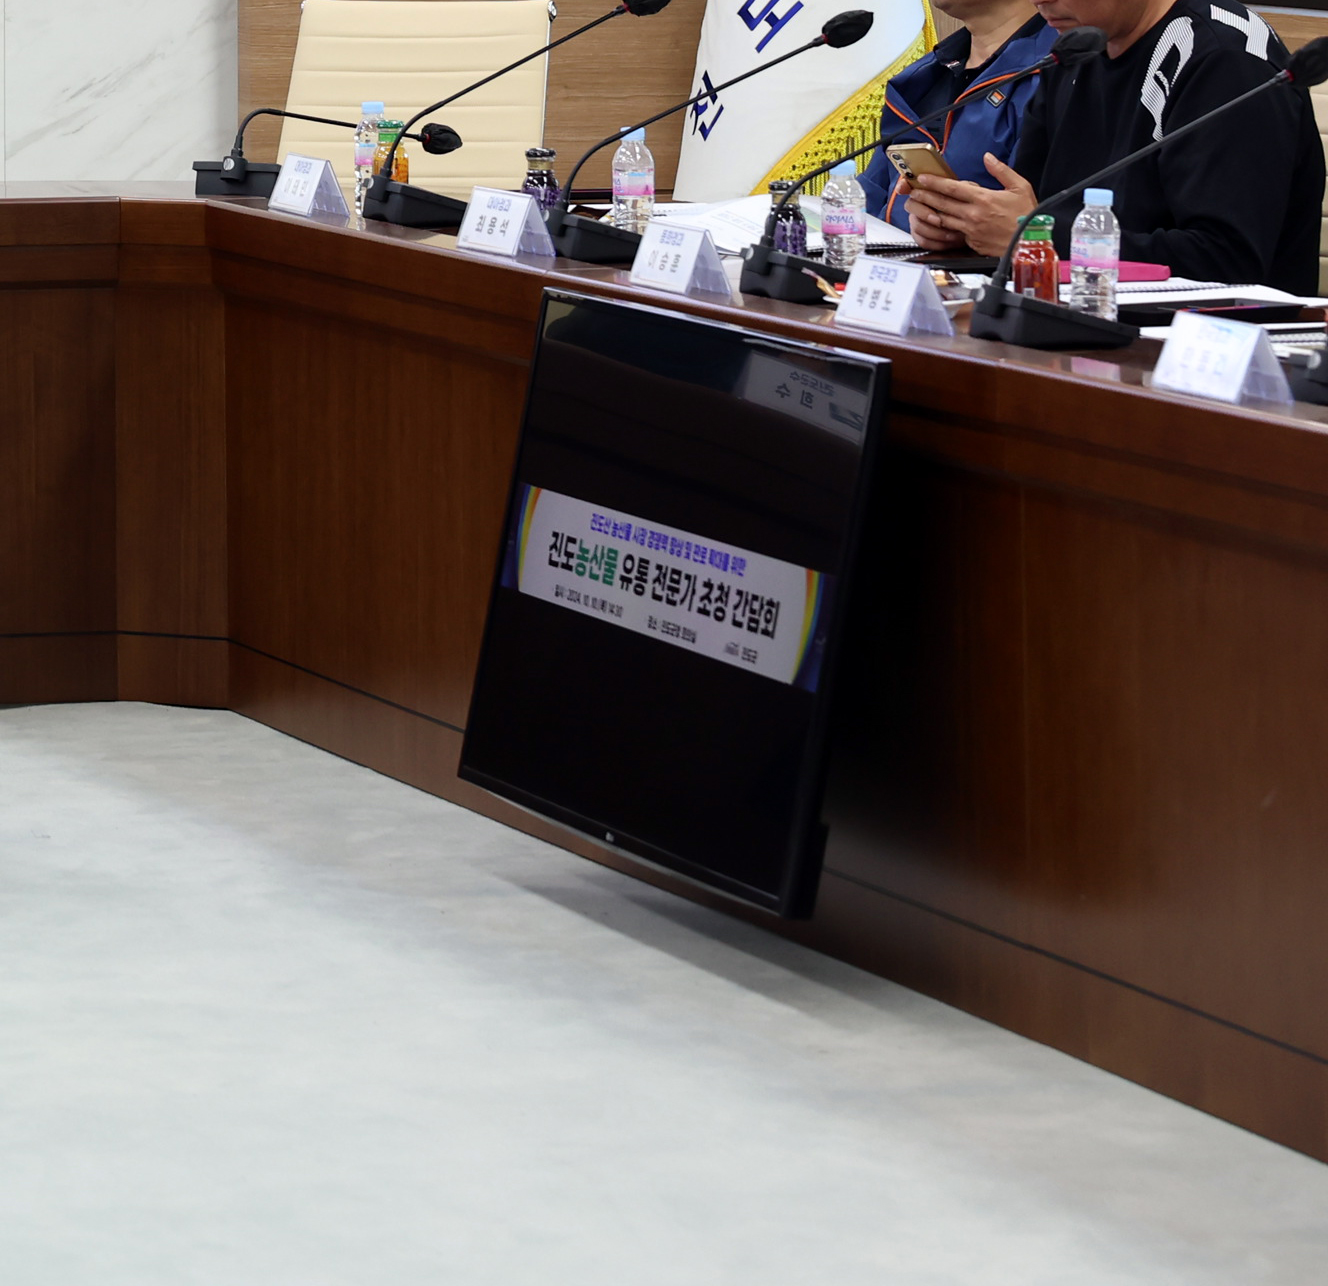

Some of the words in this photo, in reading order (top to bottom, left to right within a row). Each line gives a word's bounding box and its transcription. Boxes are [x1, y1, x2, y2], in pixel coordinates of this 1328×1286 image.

[548, 530, 619, 587] 진도농산물
[619, 553, 650, 596] 유통
[651, 562, 697, 612] 전문가
[696, 577, 731, 622] 초청
[731, 588, 780, 640] 간담회
